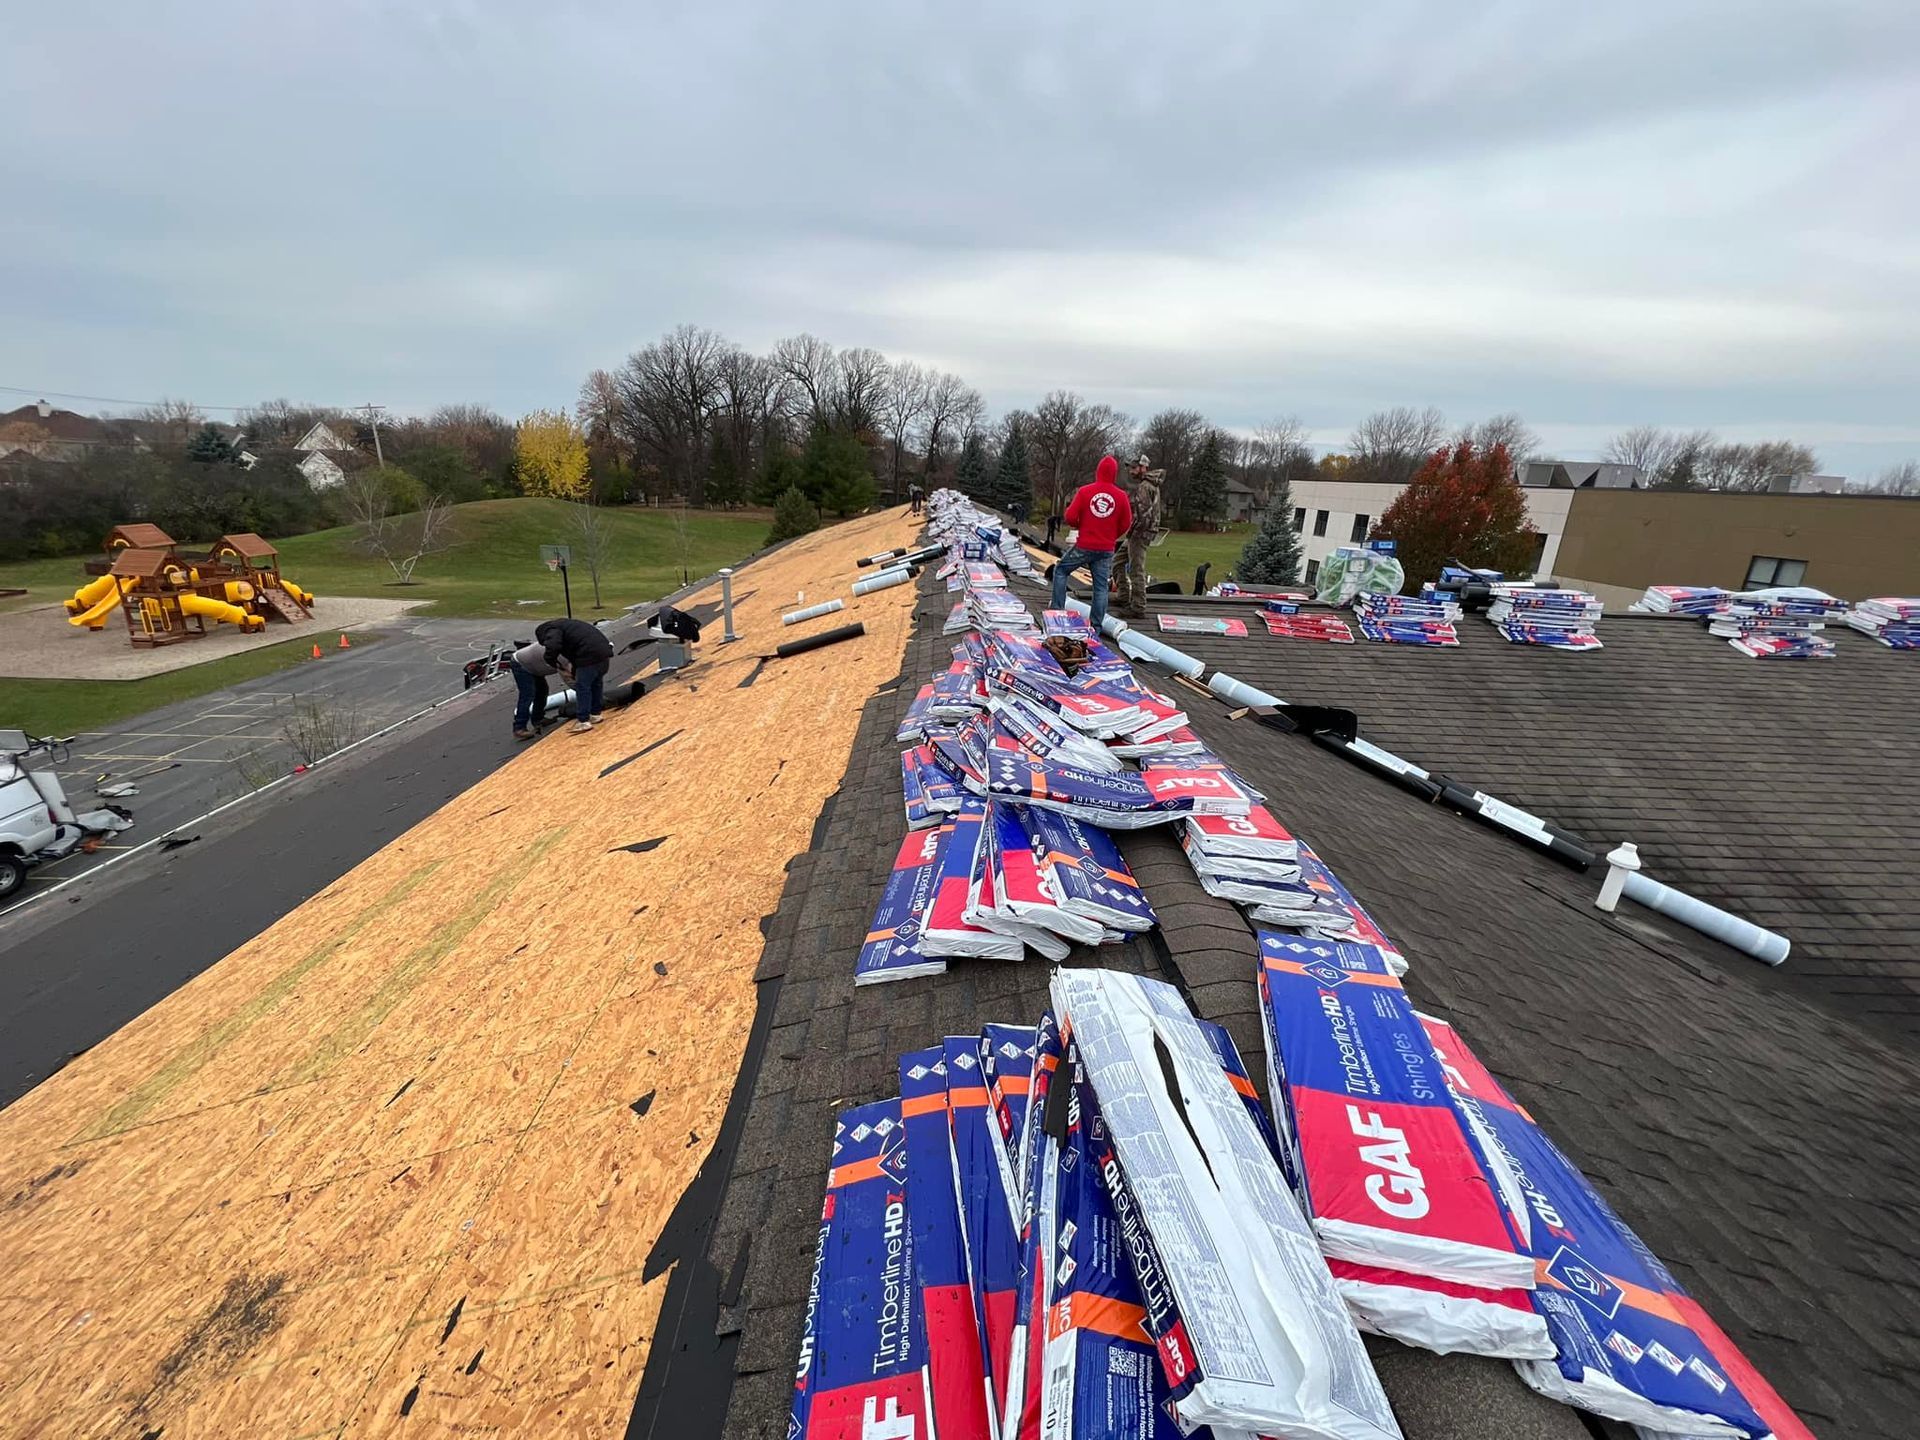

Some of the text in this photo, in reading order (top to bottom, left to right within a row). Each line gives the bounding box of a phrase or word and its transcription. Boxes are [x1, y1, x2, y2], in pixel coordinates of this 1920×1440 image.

[1156, 777, 1221, 792] GAF
[1221, 815, 1259, 834] GA
[920, 829, 940, 860] GAF
[1392, 1032, 1435, 1100] Shingles
[1347, 1104, 1430, 1220] GAF
[900, 1284, 910, 1334] Definition
[1059, 1297, 1071, 1332] MC
[899, 1336, 909, 1361] High
[1165, 1335, 1185, 1378] GAF
[1046, 1408, 1057, 1430] 10
